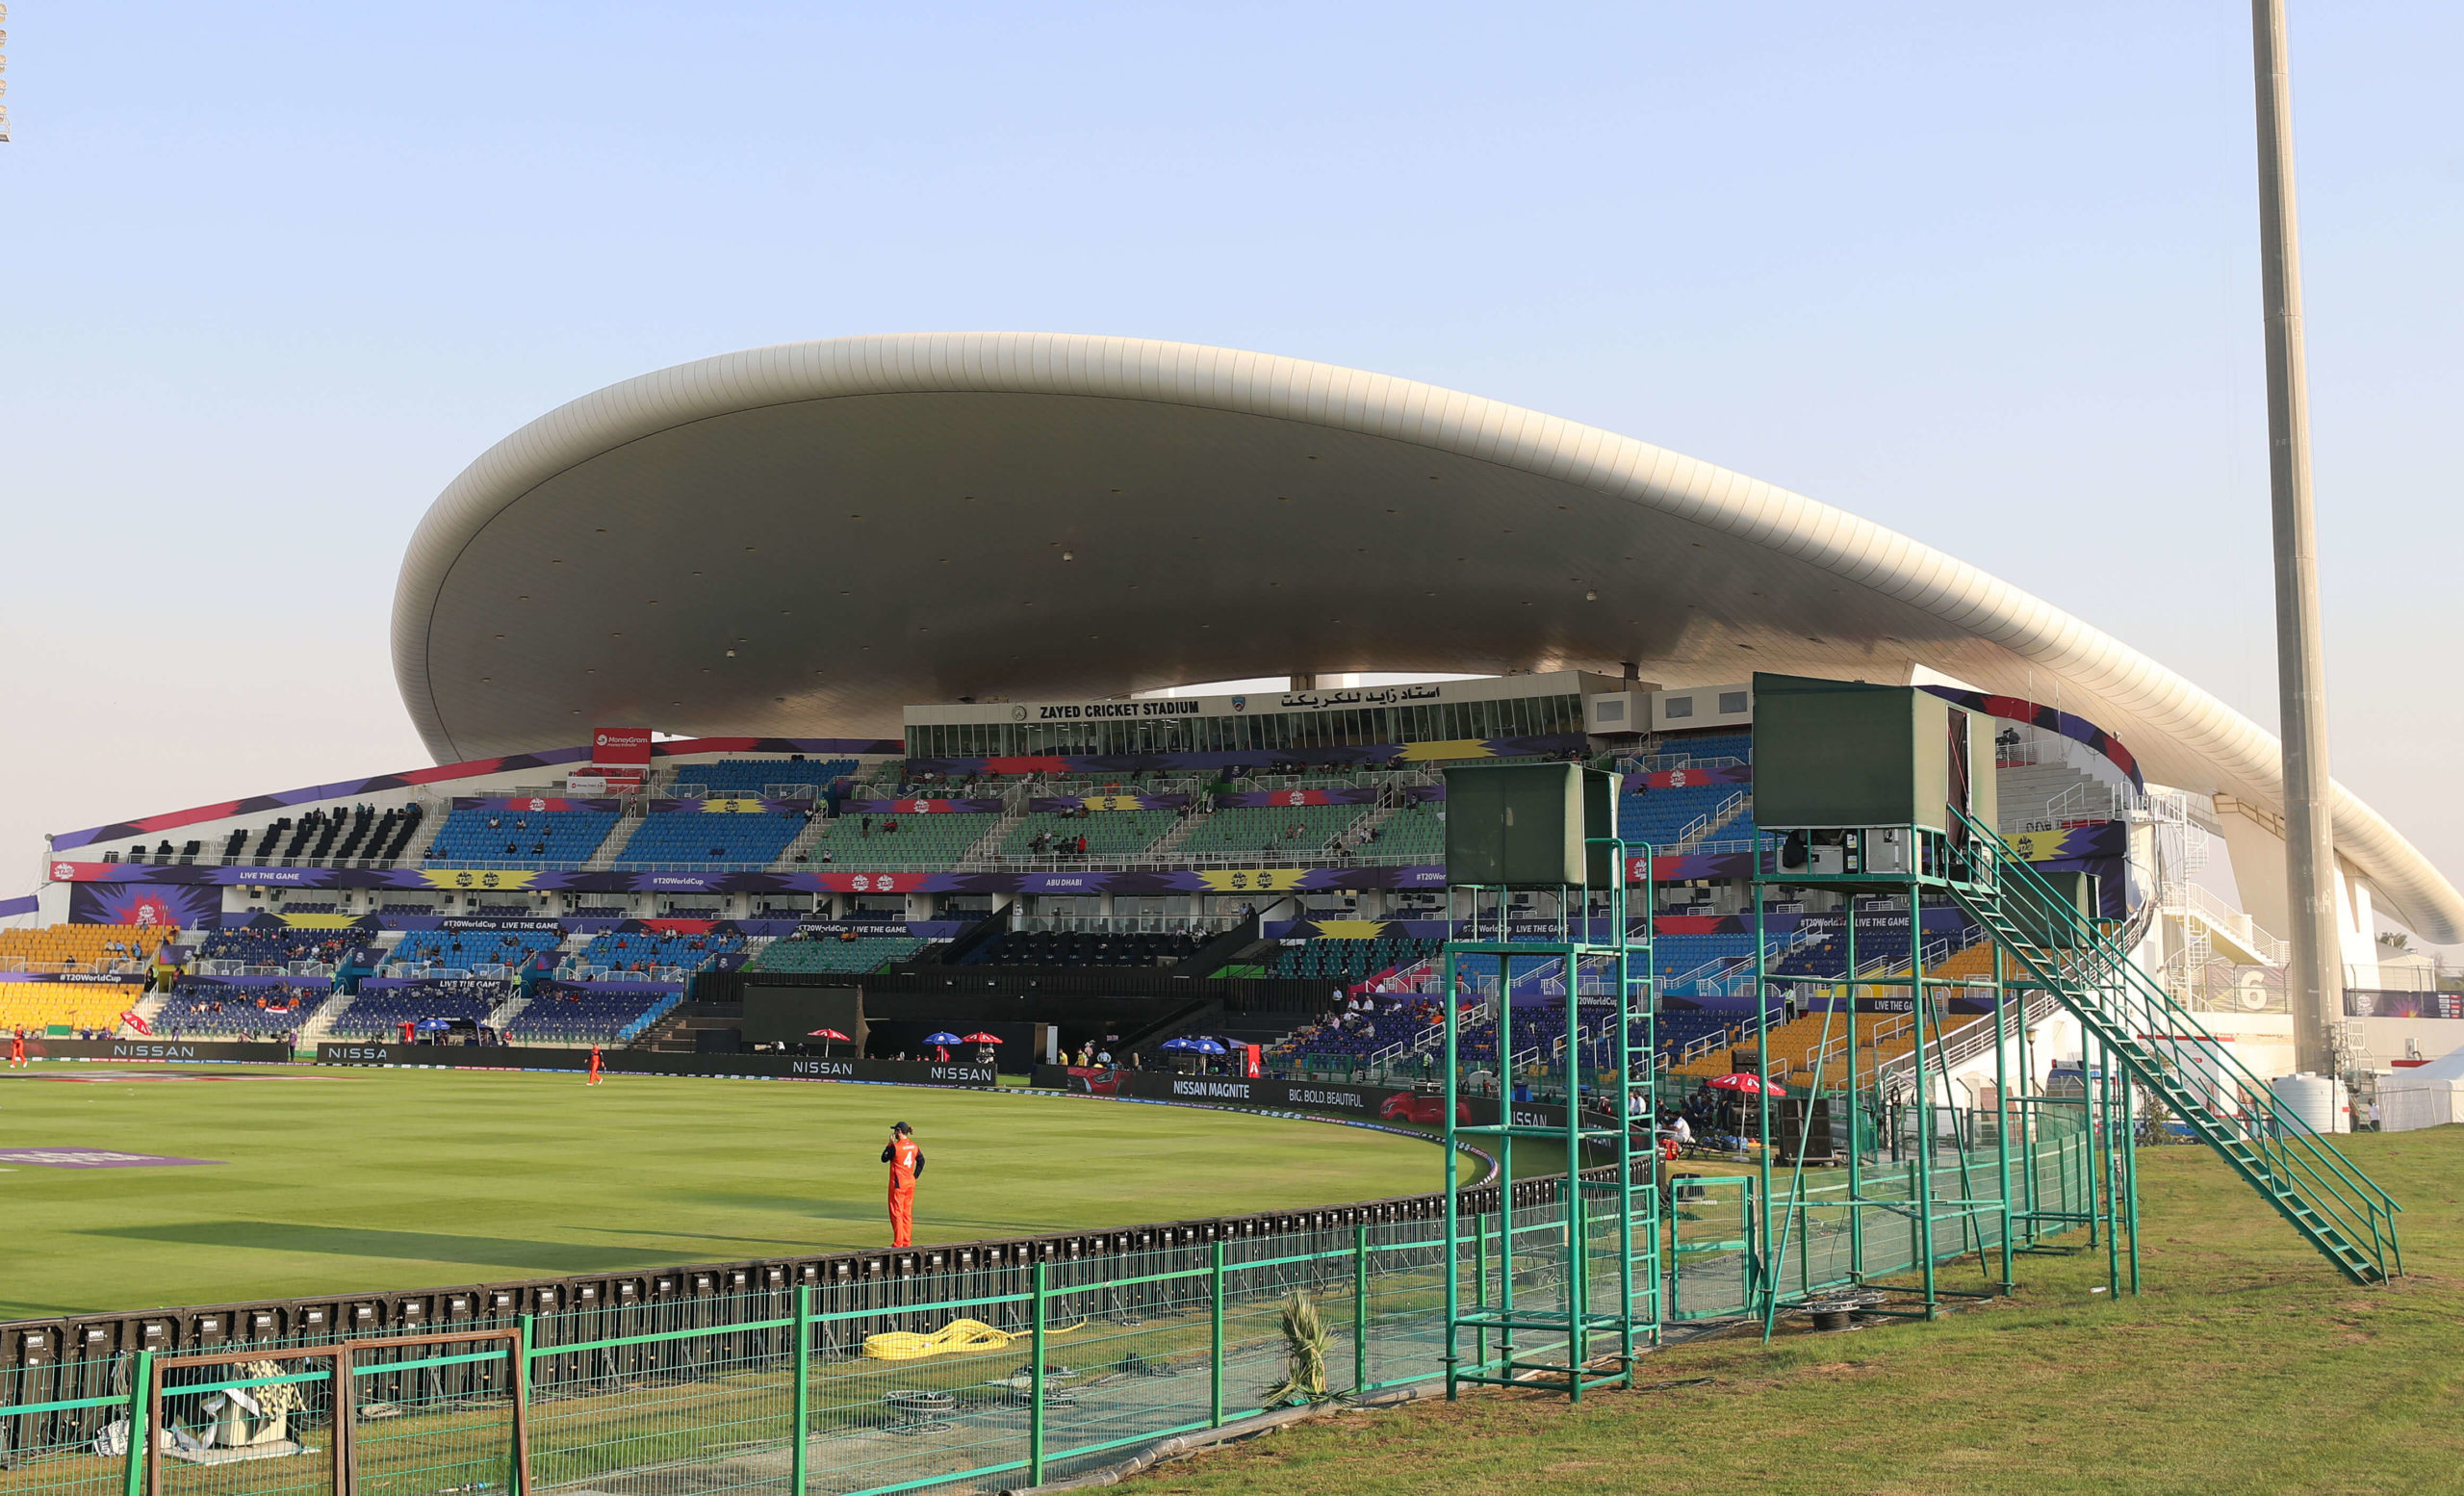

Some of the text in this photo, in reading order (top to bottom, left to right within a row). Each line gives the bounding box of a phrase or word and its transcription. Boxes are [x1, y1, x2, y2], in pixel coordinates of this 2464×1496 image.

[1281, 685, 1441, 709] استاد زايد للكريكت
[1040, 700, 1199, 719] ZAYED CRICKET STADIUM
[653, 877, 705, 886] #T20WorldCup
[443, 919, 497, 929] #T20WorldCup
[1855, 917, 1871, 927] LIVE
[1872, 917, 1886, 927] THE
[1887, 916, 1910, 927] GAME
[1516, 924, 1532, 933] LIVE
[1532, 924, 1548, 933] THE
[2241, 970, 2268, 1011] 6
[1874, 1001, 1889, 1010] LIVE
[1889, 1001, 1903, 1010] THE
[114, 1045, 194, 1057] NISSAN
[328, 1047, 387, 1059] NISSA
[793, 1061, 853, 1074] NISSAN
[931, 1067, 992, 1081] NISSAN
[1173, 1080, 1250, 1098] NISSAN MAGNITE
[1289, 1088, 1303, 1102] BIG.
[1303, 1090, 1326, 1103] BOLD.
[903, 1150, 913, 1169] 4
